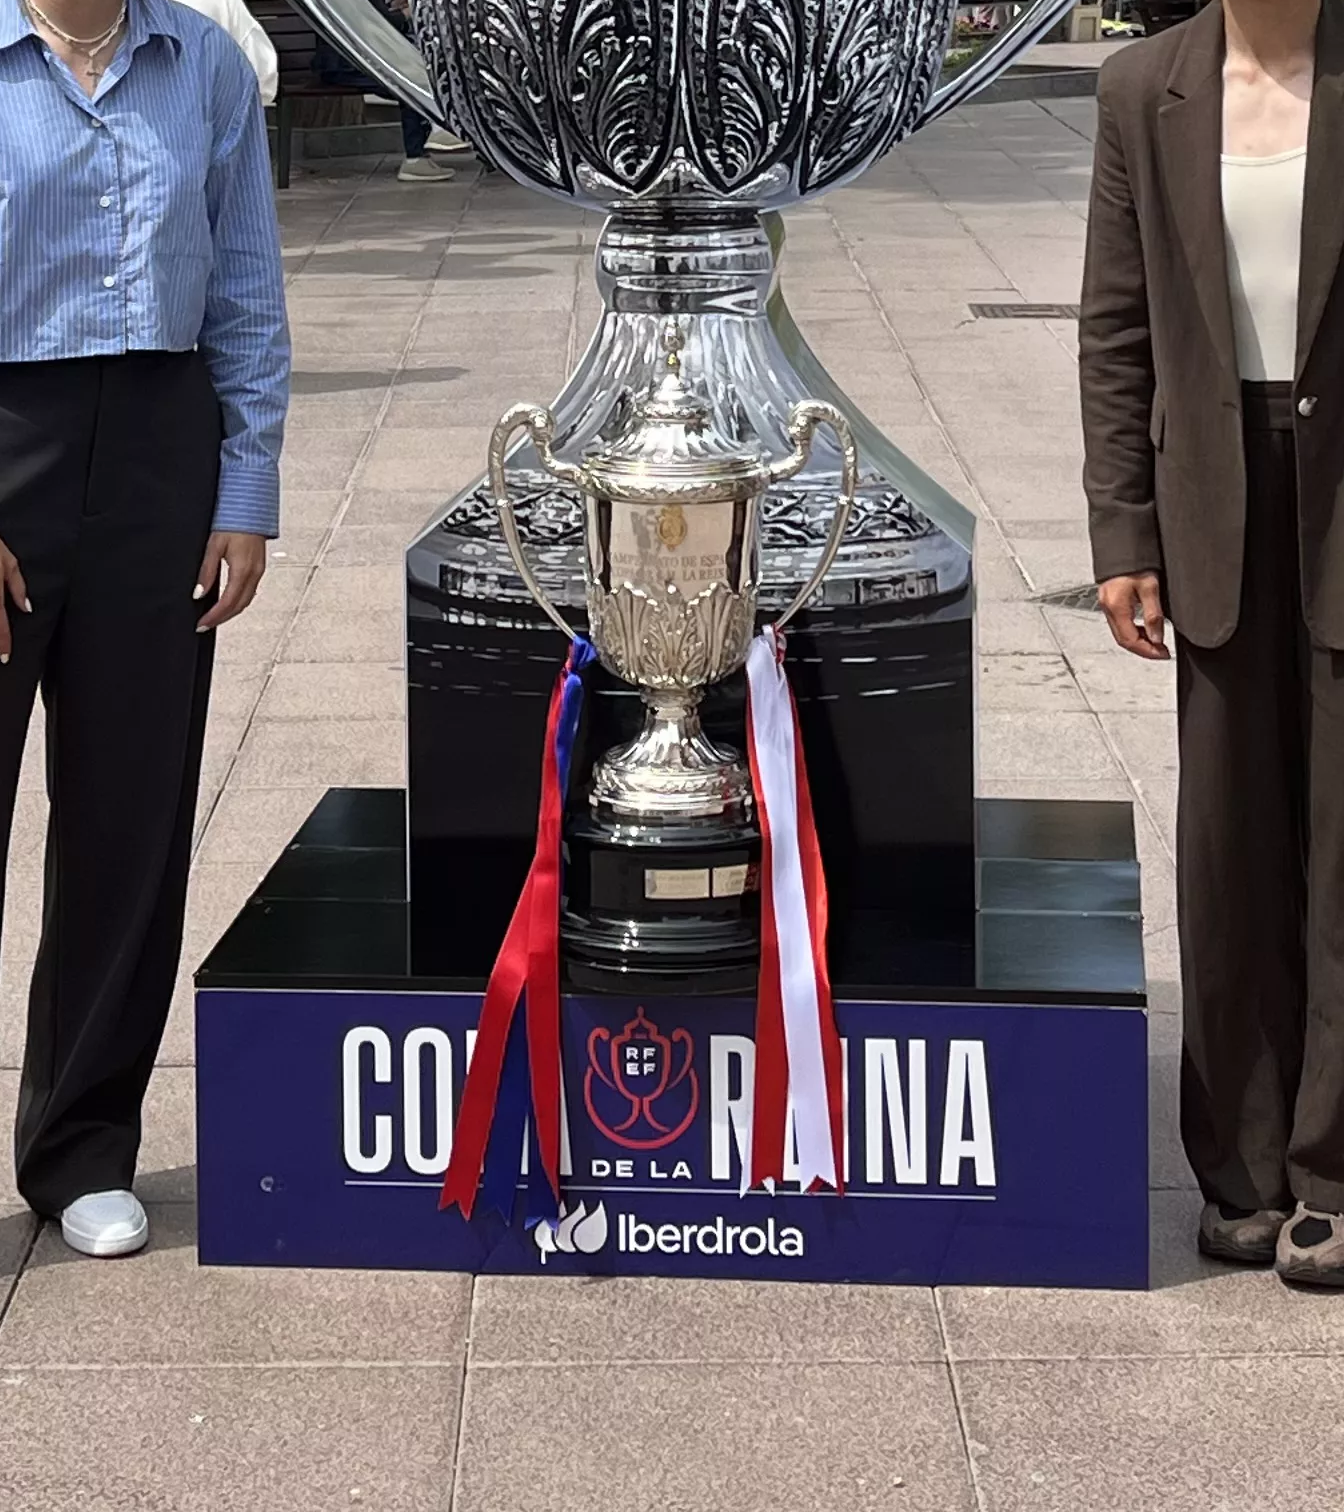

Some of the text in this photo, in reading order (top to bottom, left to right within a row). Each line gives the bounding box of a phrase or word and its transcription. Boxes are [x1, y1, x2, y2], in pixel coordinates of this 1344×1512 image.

[591, 1159, 634, 1178] DE
[650, 1160, 692, 1180] LA
[618, 1213, 804, 1257] Iberdrola
